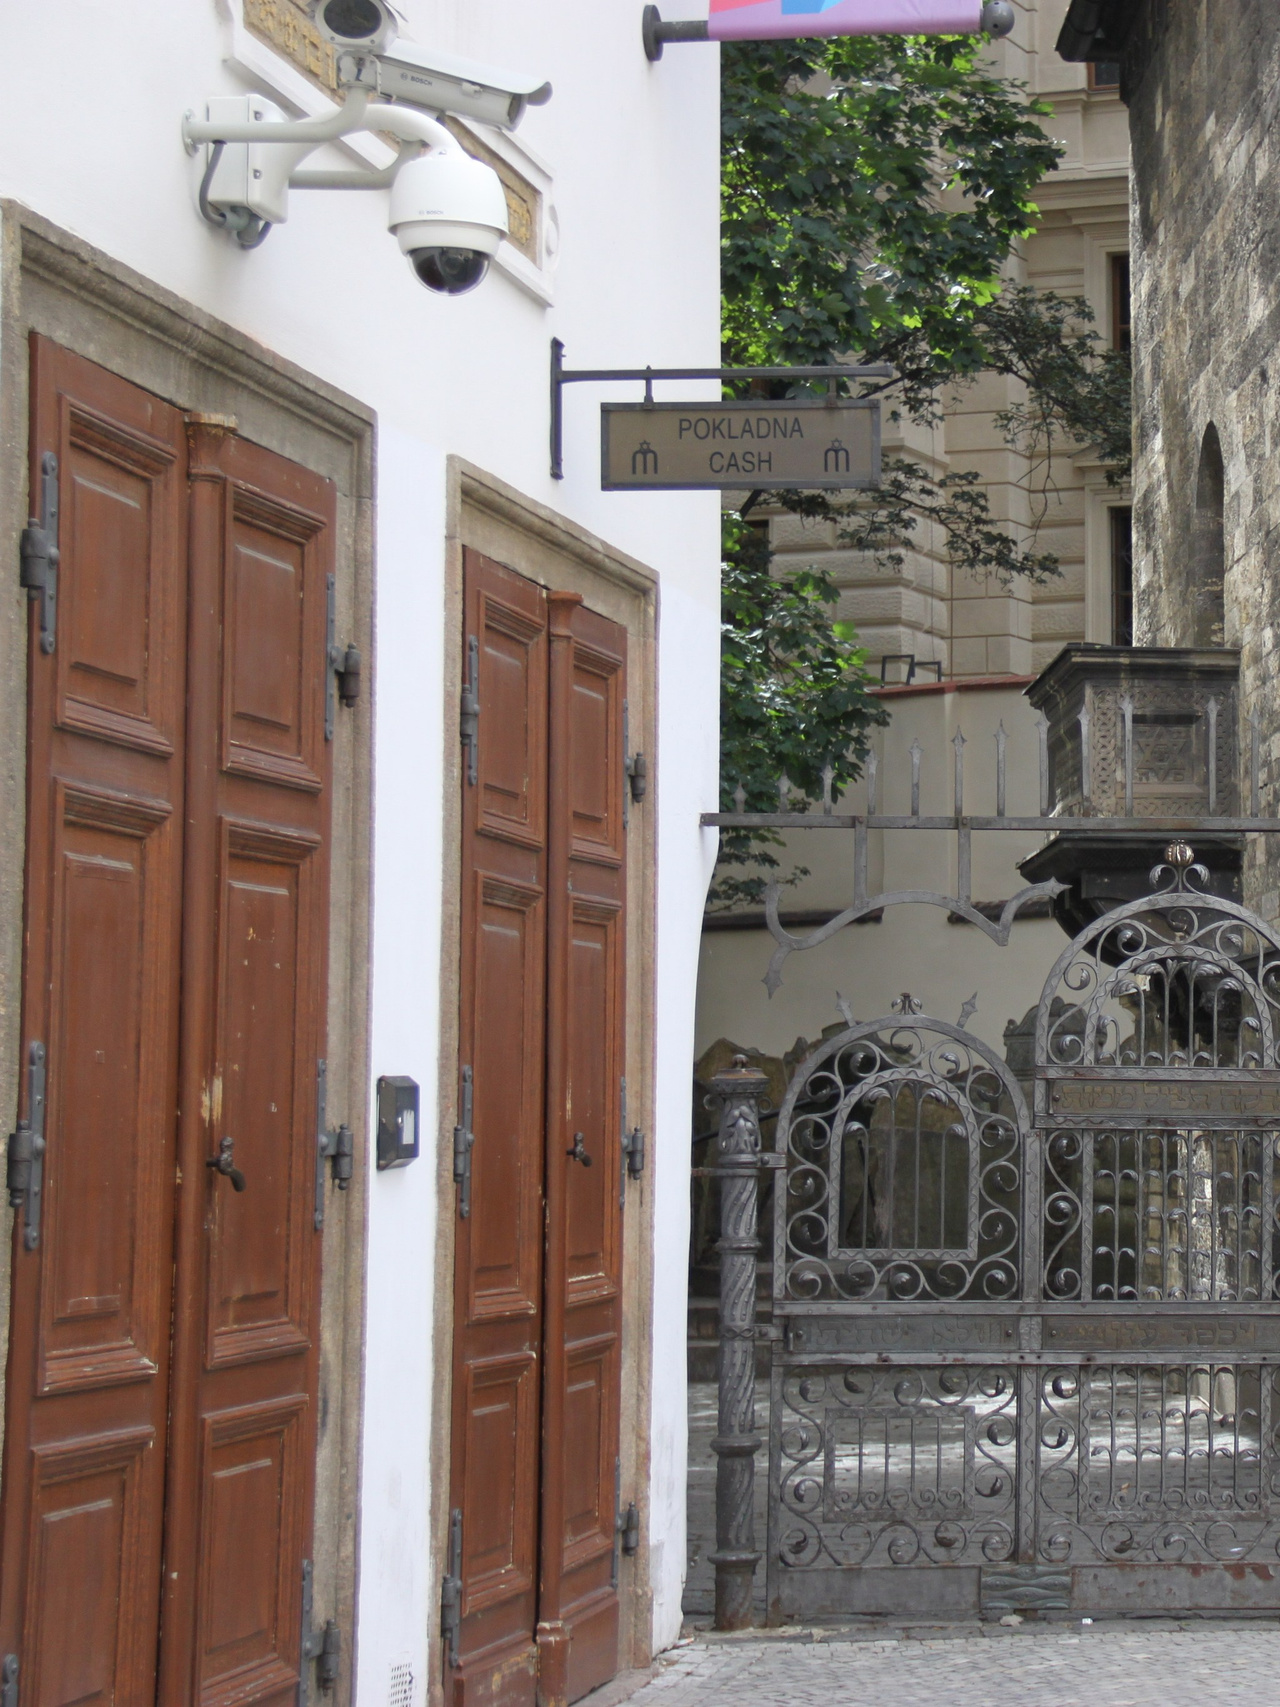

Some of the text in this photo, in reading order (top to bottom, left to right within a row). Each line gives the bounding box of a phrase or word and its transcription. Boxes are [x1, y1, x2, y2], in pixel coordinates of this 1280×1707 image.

[410, 76, 432, 86] BOSCH
[679, 417, 803, 440] POKLADNA
[709, 451, 772, 473] CASH
